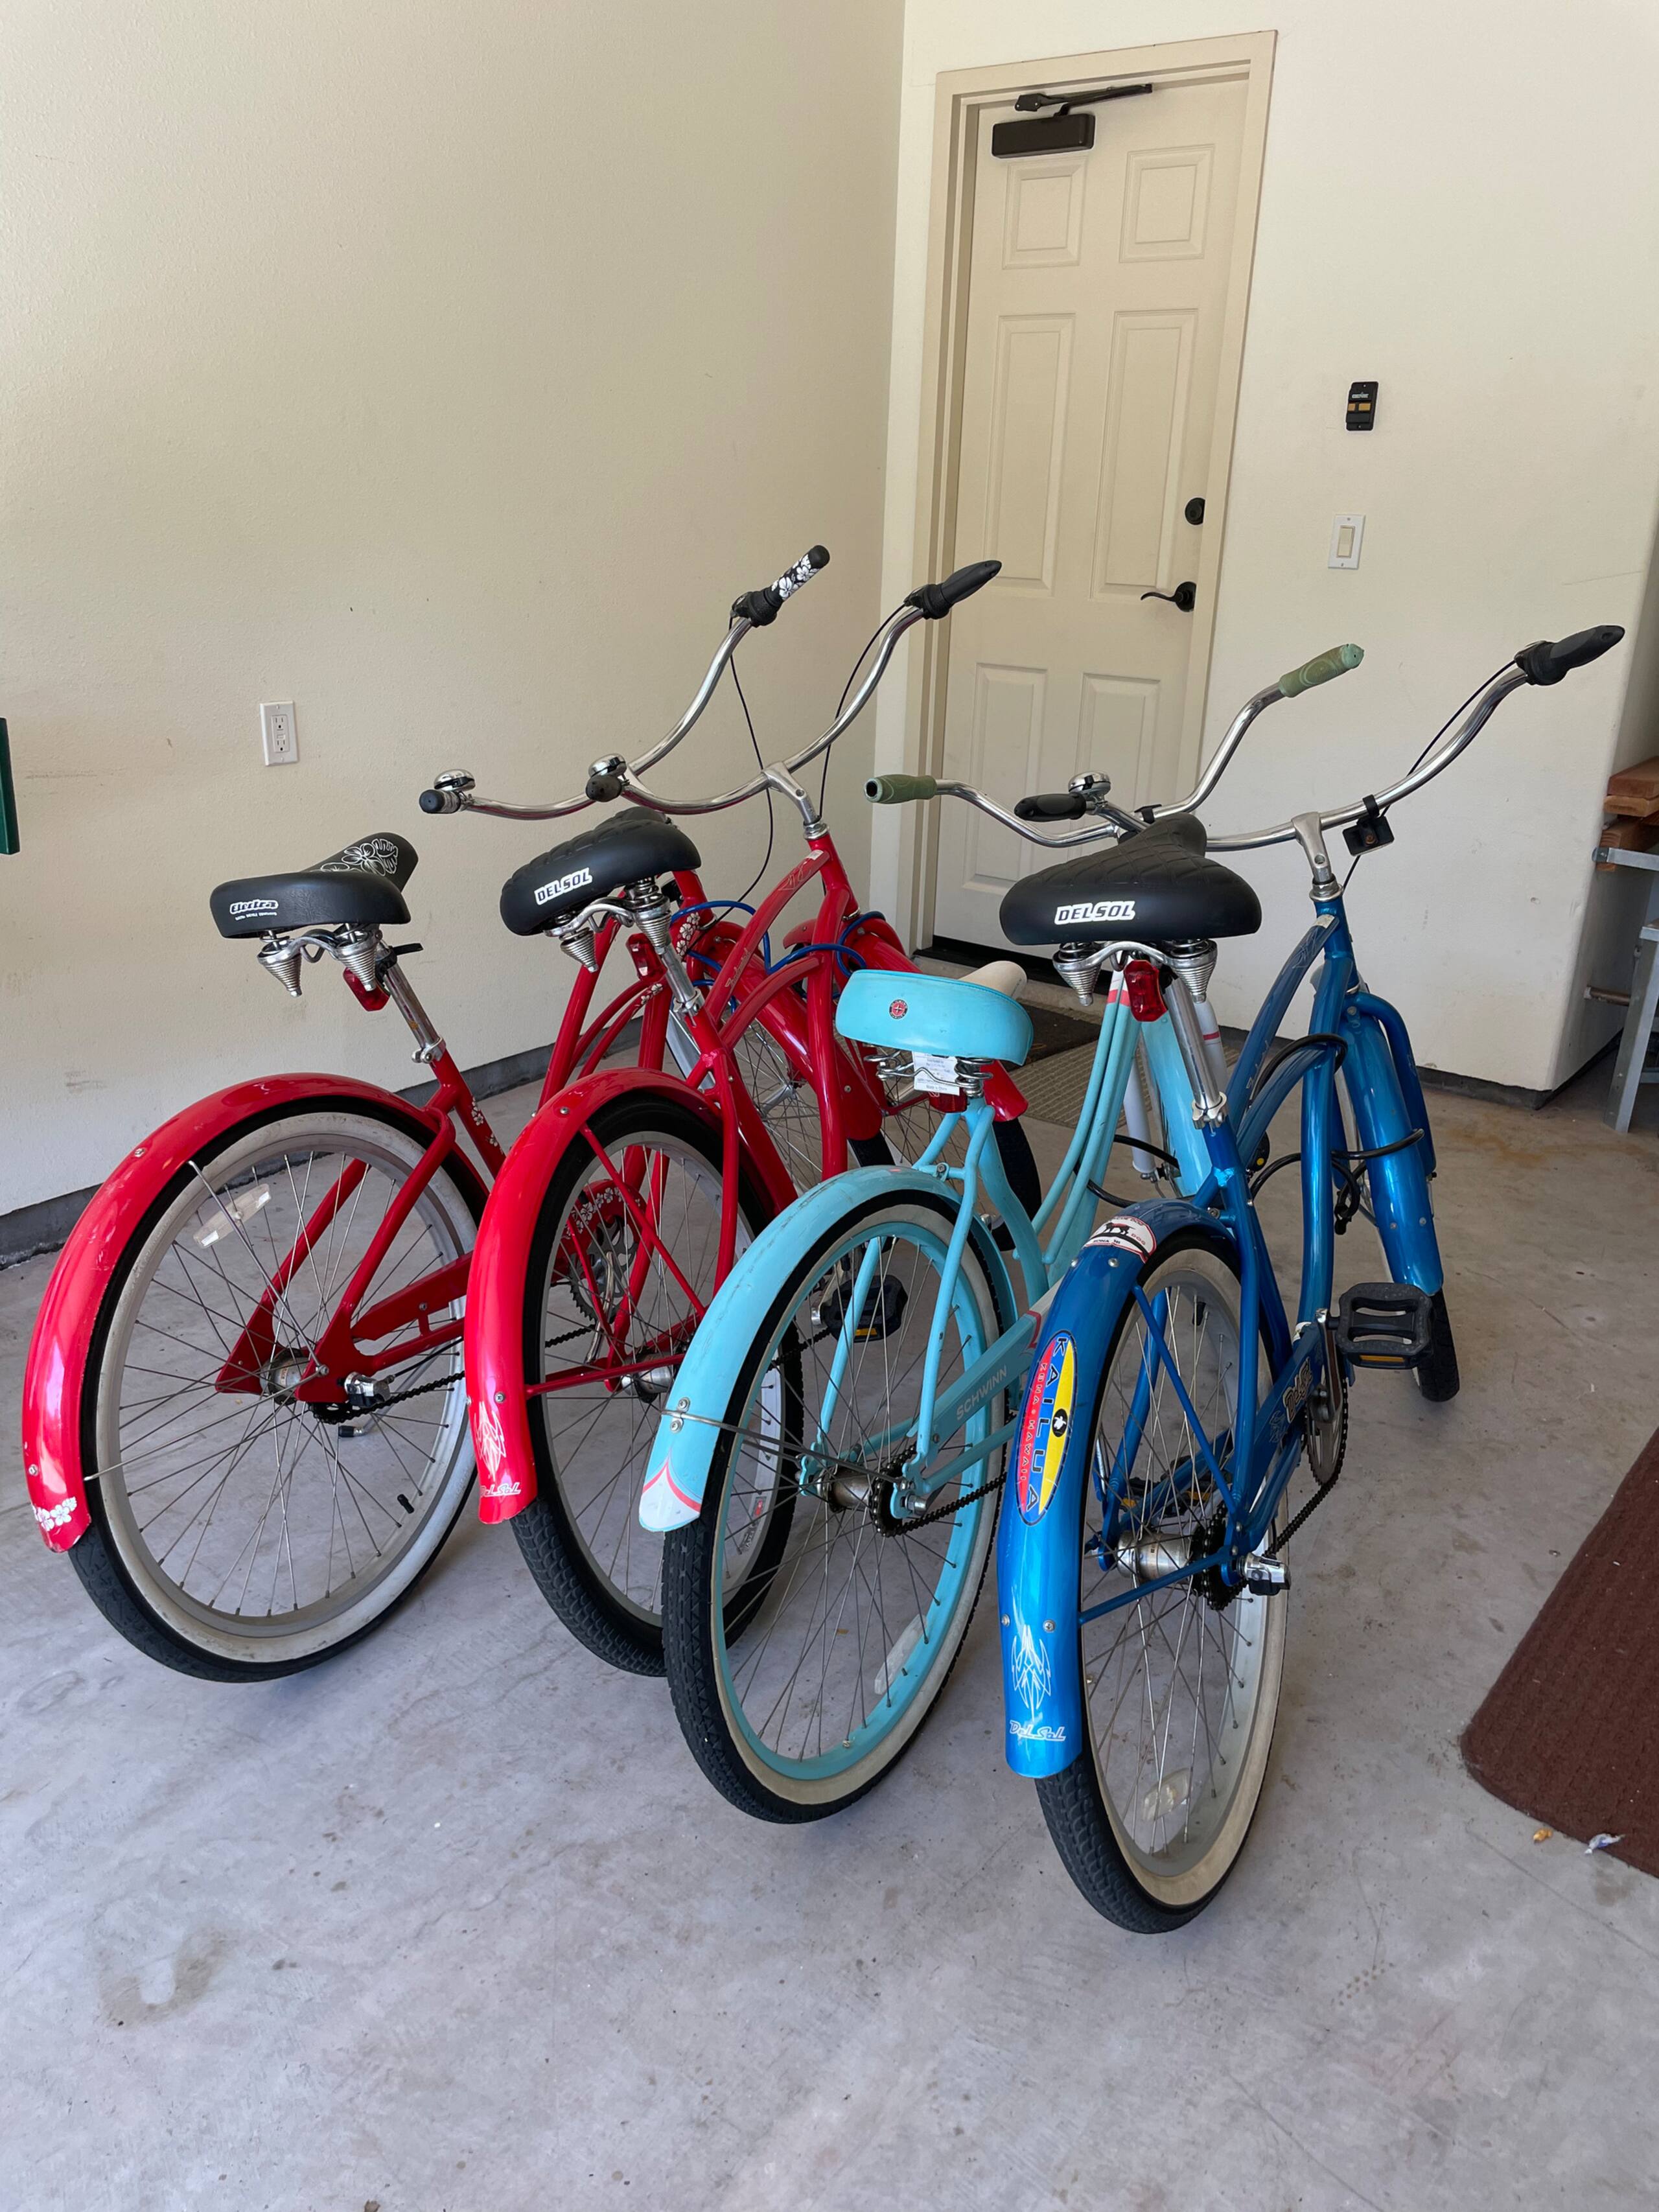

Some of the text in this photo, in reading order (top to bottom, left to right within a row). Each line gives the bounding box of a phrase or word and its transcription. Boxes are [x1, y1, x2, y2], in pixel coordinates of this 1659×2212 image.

[231, 900, 277, 914] Electra
[956, 1364, 1006, 1421] SCHWINN
[1020, 1419, 1036, 1481] HAWAII
[1027, 1337, 1069, 1511] KAILUA
